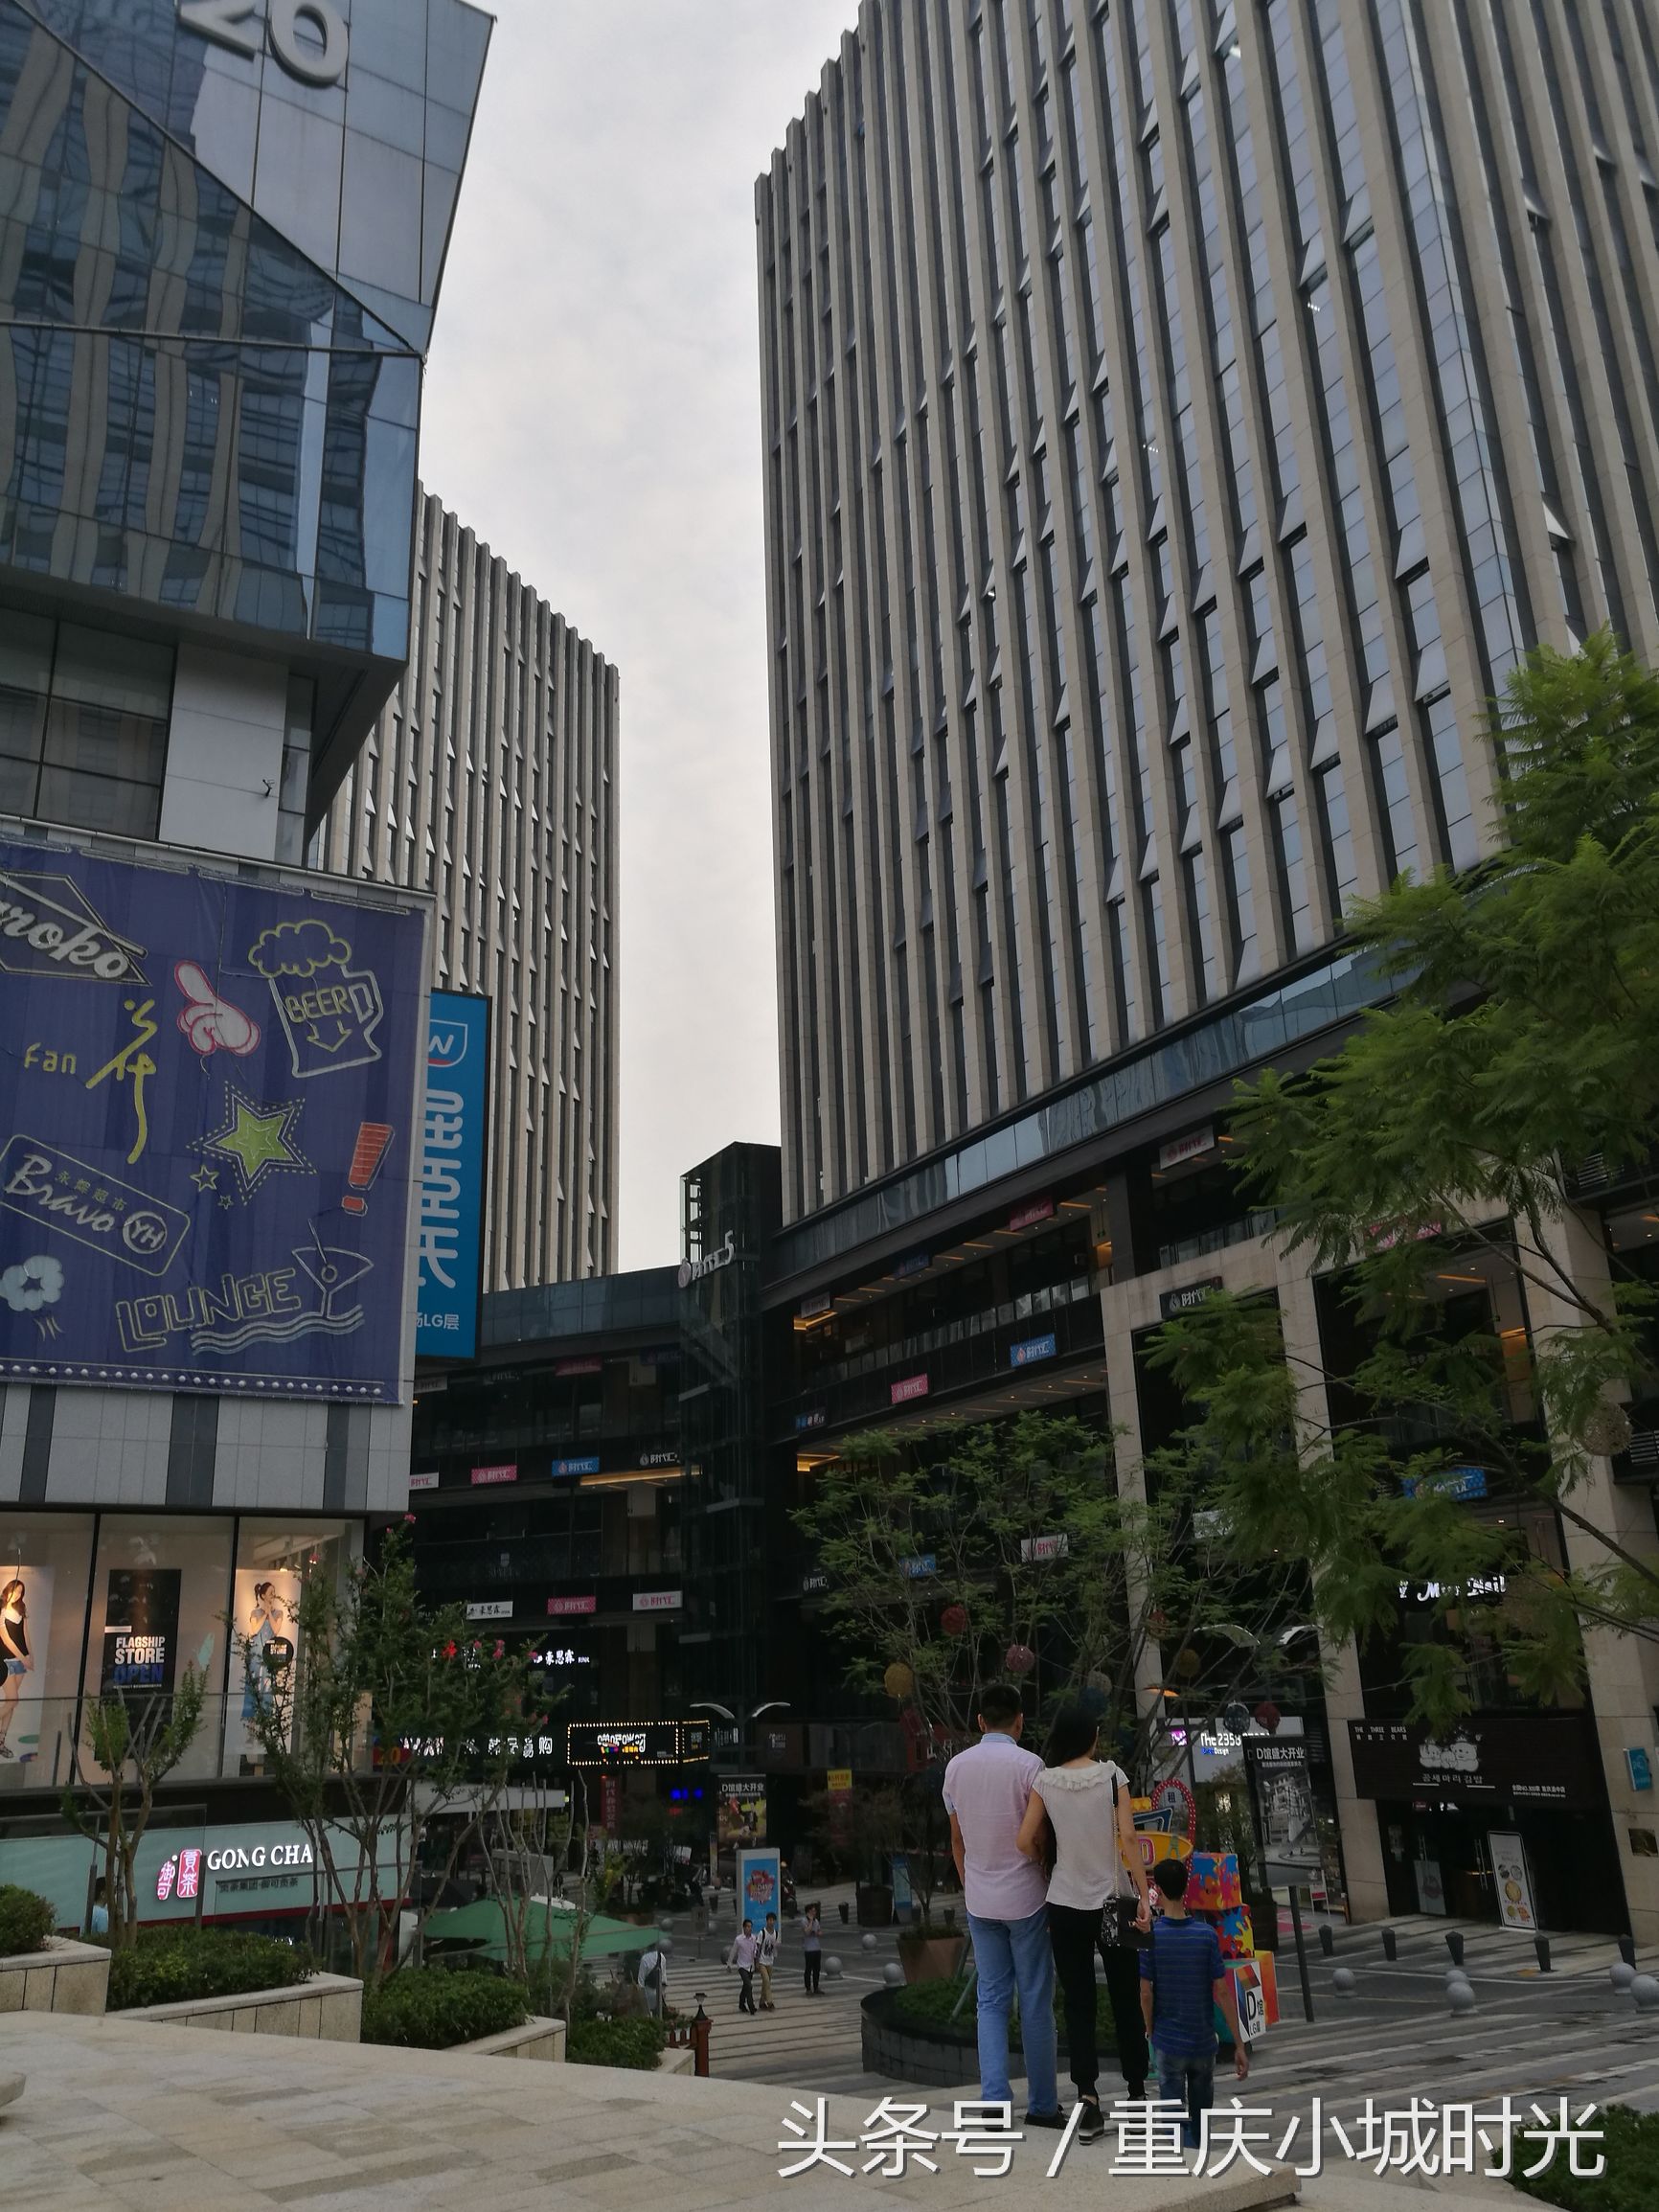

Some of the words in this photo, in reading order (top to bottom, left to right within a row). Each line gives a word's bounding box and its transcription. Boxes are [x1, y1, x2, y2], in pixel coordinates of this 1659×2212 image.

[4, 1152, 116, 1232] Bravo
[115, 1267, 301, 1353] LOUNGE
[115, 1636, 166, 1649] FLAGSHIP
[114, 1648, 166, 1664] STORE
[112, 1664, 164, 1683] OPEN
[1256, 1746, 1306, 1761] D馆盛大开业
[207, 1846, 266, 1871] GONG
[270, 1843, 314, 1866] CHA
